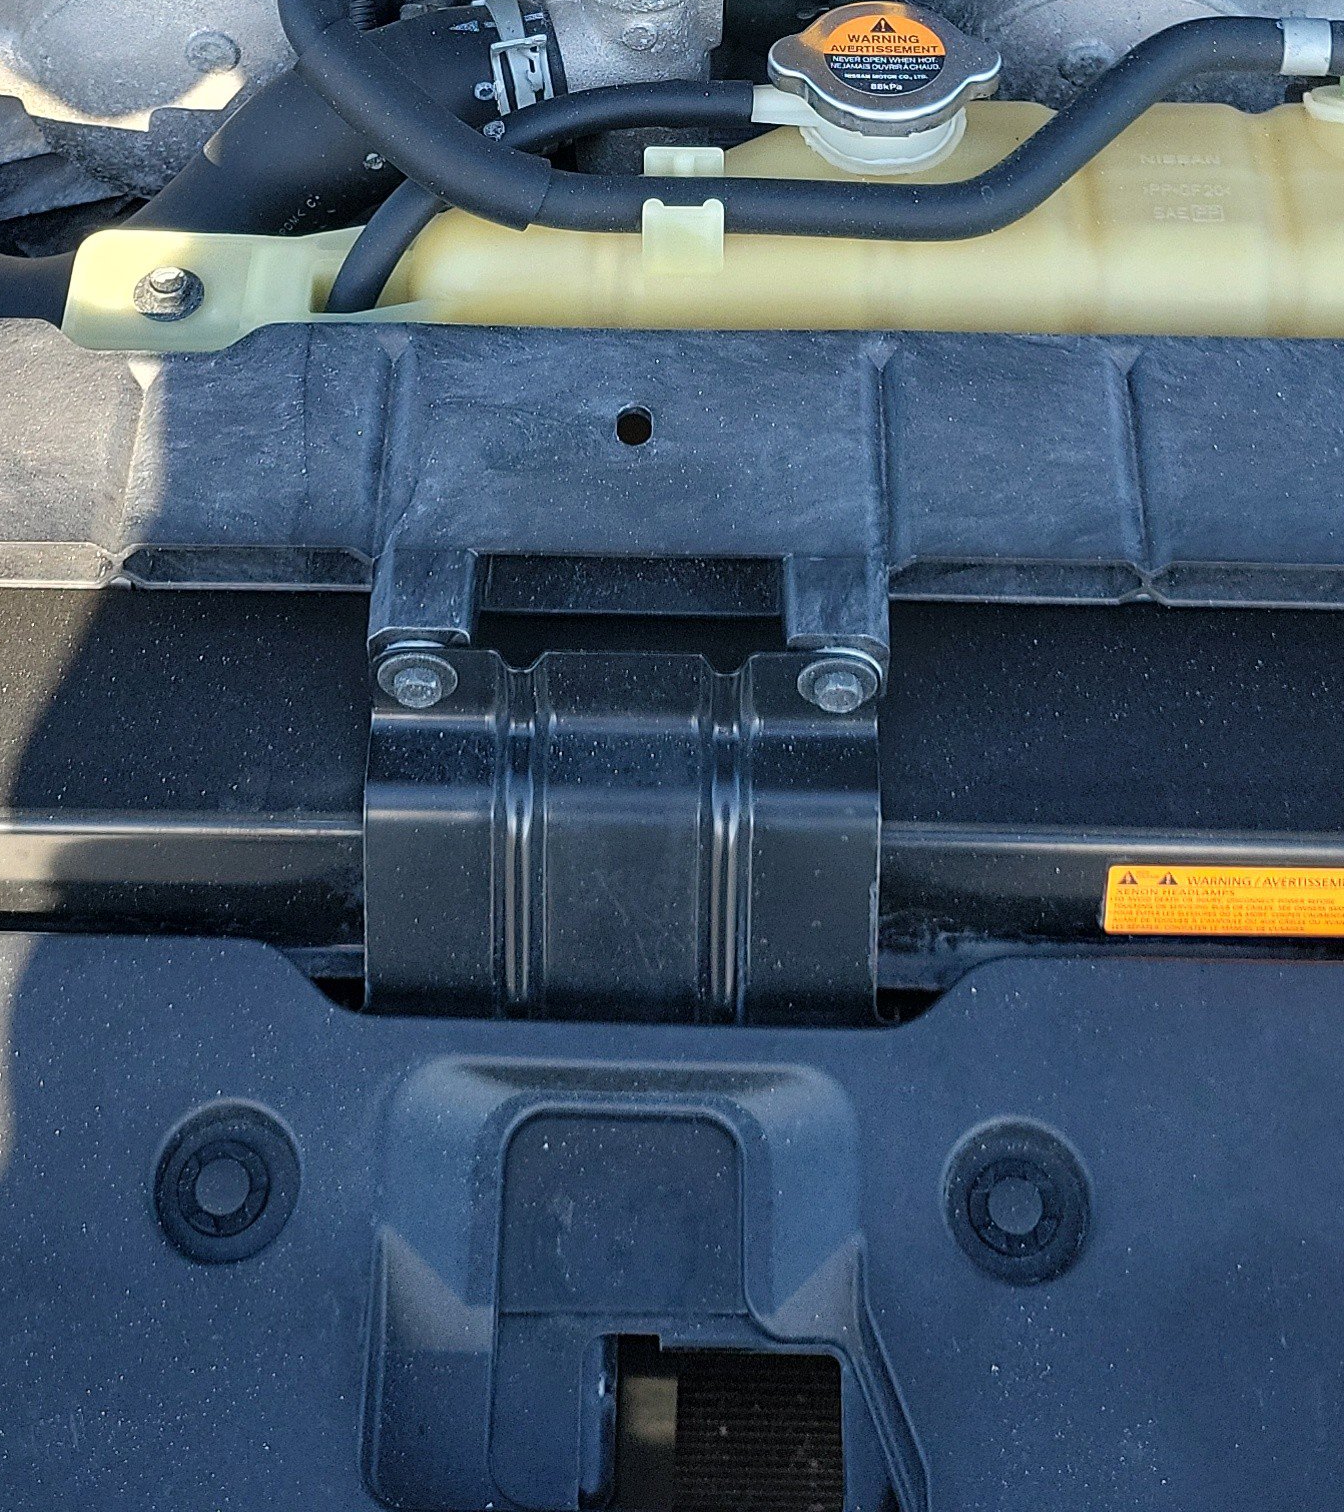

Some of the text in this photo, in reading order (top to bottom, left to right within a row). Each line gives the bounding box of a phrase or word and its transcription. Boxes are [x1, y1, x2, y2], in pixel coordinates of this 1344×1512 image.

[847, 34, 920, 44] WARNING
[830, 45, 939, 54] AVERTISSEMENT
[862, 56, 887, 64] OPEN
[1140, 154, 1221, 166] NISSAN
[1187, 876, 1252, 886] WARNING
[1162, 888, 1235, 896] HEADLAMPS
